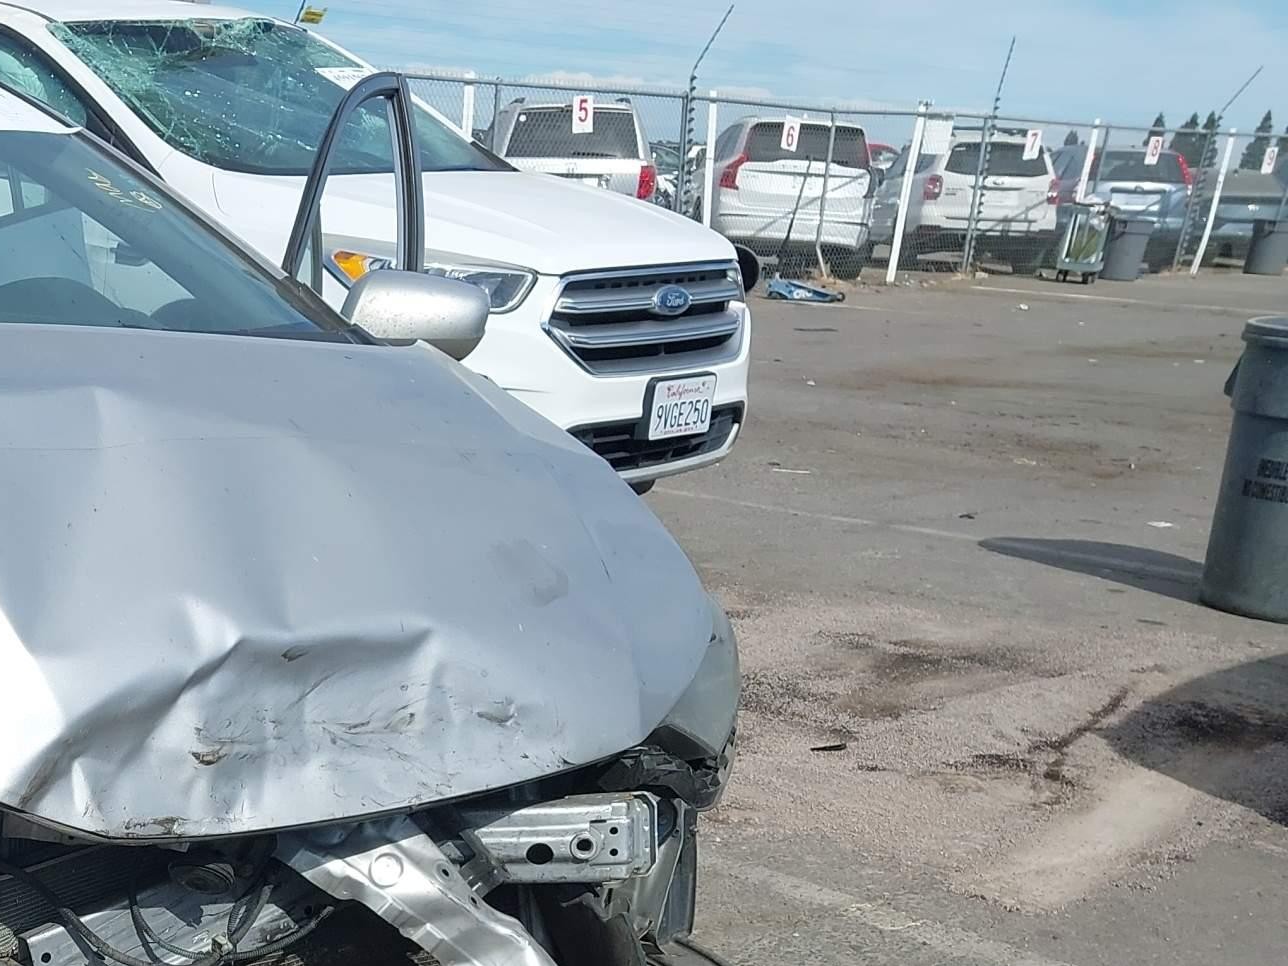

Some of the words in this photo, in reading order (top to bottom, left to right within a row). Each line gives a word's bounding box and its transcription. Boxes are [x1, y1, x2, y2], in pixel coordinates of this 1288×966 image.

[578, 98, 588, 123] 5
[786, 125, 795, 147] 6
[1030, 132, 1039, 151] 7
[1151, 139, 1160, 157] 8
[666, 292, 685, 307] Ford
[666, 384, 703, 400] California
[655, 398, 709, 431] 9VGE250
